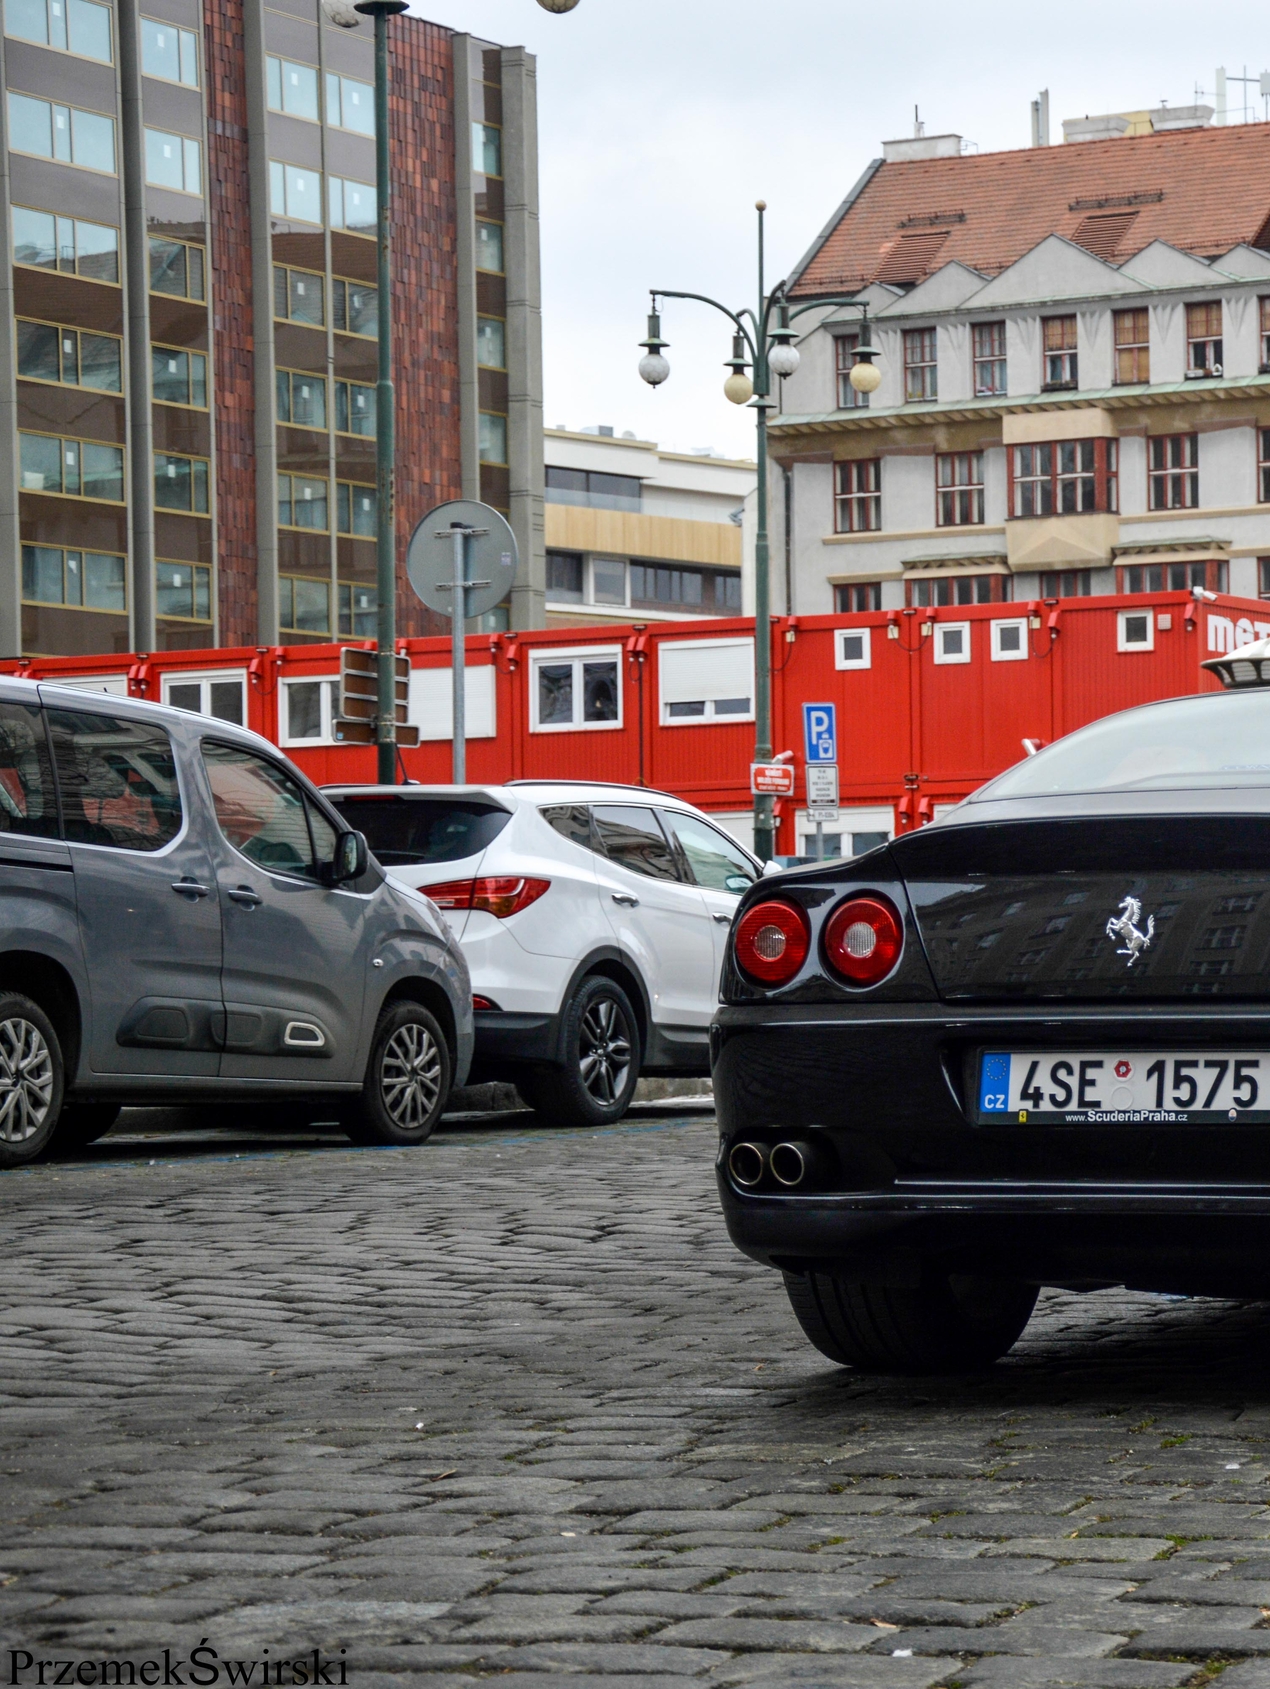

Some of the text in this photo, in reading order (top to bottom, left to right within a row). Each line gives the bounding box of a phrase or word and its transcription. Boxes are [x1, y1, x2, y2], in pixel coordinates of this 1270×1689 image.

[810, 711, 829, 745] P
[1019, 1059, 1260, 1110] 4SE 1575
[984, 1094, 1006, 1109] CZ
[1065, 1110, 1188, 1122] www.ScuderiaPraha.cz
